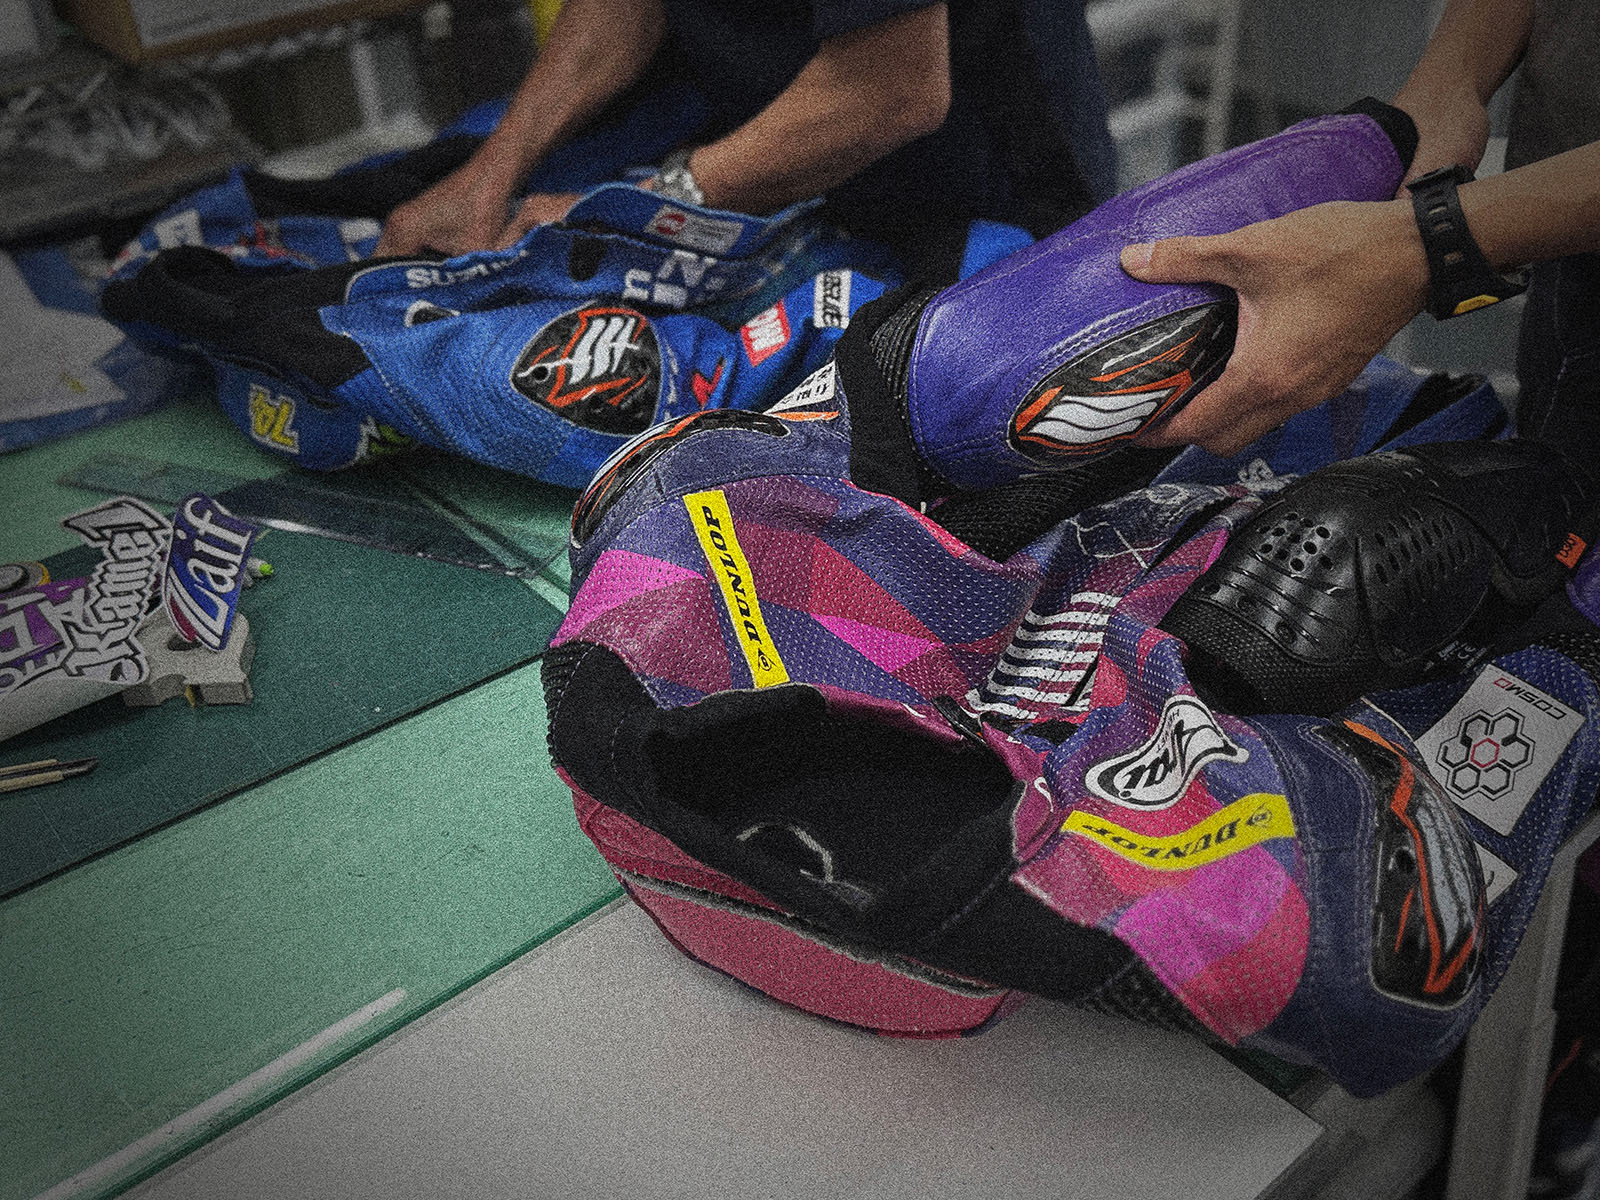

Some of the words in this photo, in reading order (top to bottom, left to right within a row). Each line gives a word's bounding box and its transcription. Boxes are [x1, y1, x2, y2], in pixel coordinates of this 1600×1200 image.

[168, 496, 252, 648] Zaif
[702, 505, 762, 645] DUNLOP
[1493, 677, 1567, 720] COSMO
[1118, 719, 1210, 800] Arai
[1081, 817, 1242, 860] DUNLOP
